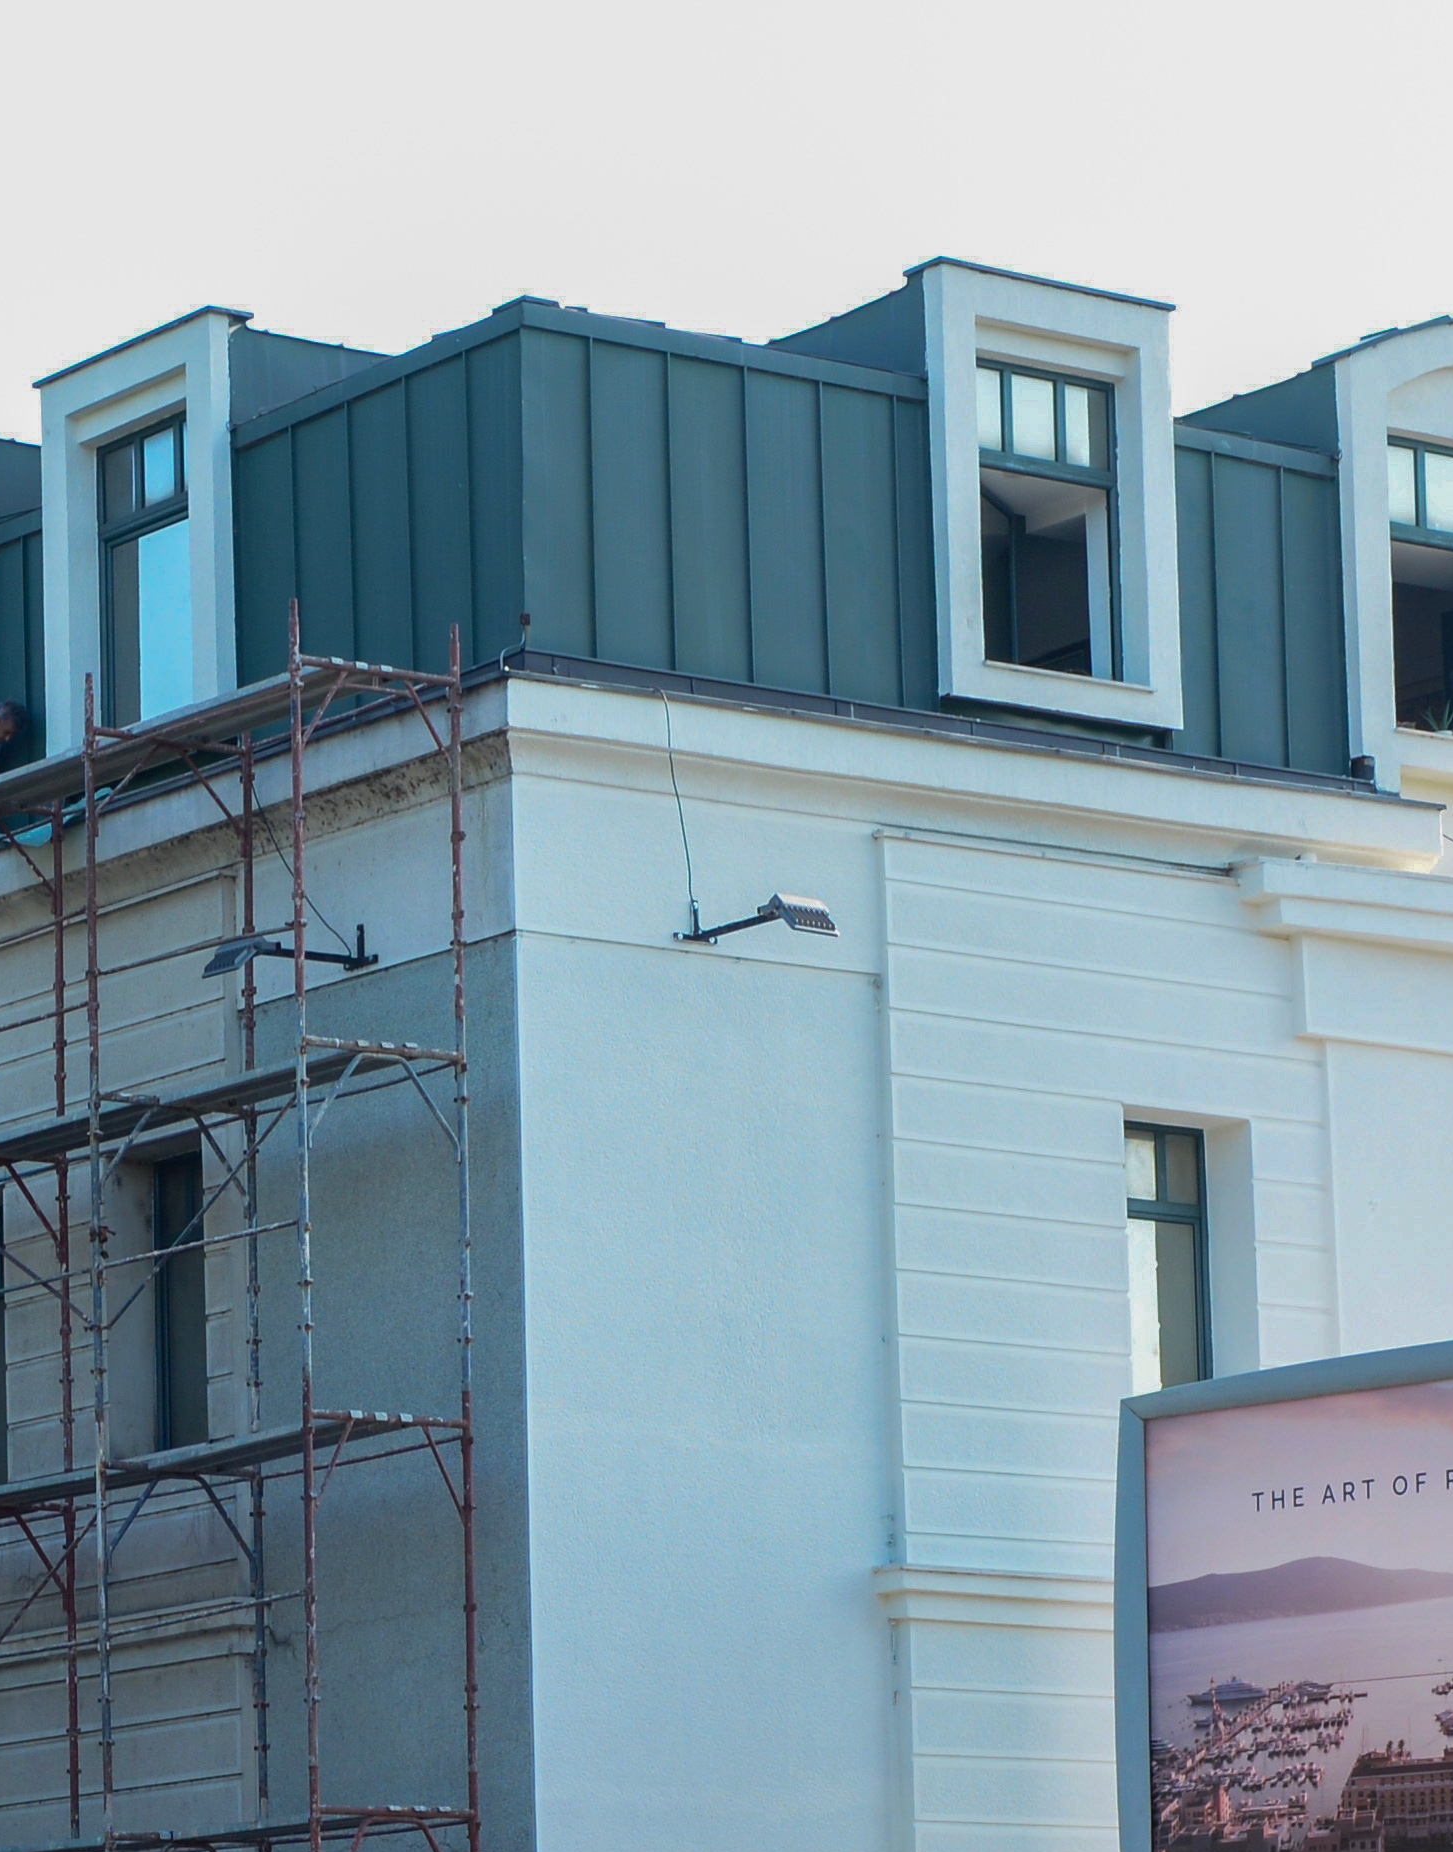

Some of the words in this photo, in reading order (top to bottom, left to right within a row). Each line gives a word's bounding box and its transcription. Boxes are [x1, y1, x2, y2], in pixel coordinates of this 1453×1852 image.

[1251, 1487, 1305, 1513] THE
[1321, 1478, 1376, 1505] ART
[1392, 1472, 1427, 1497] OF
